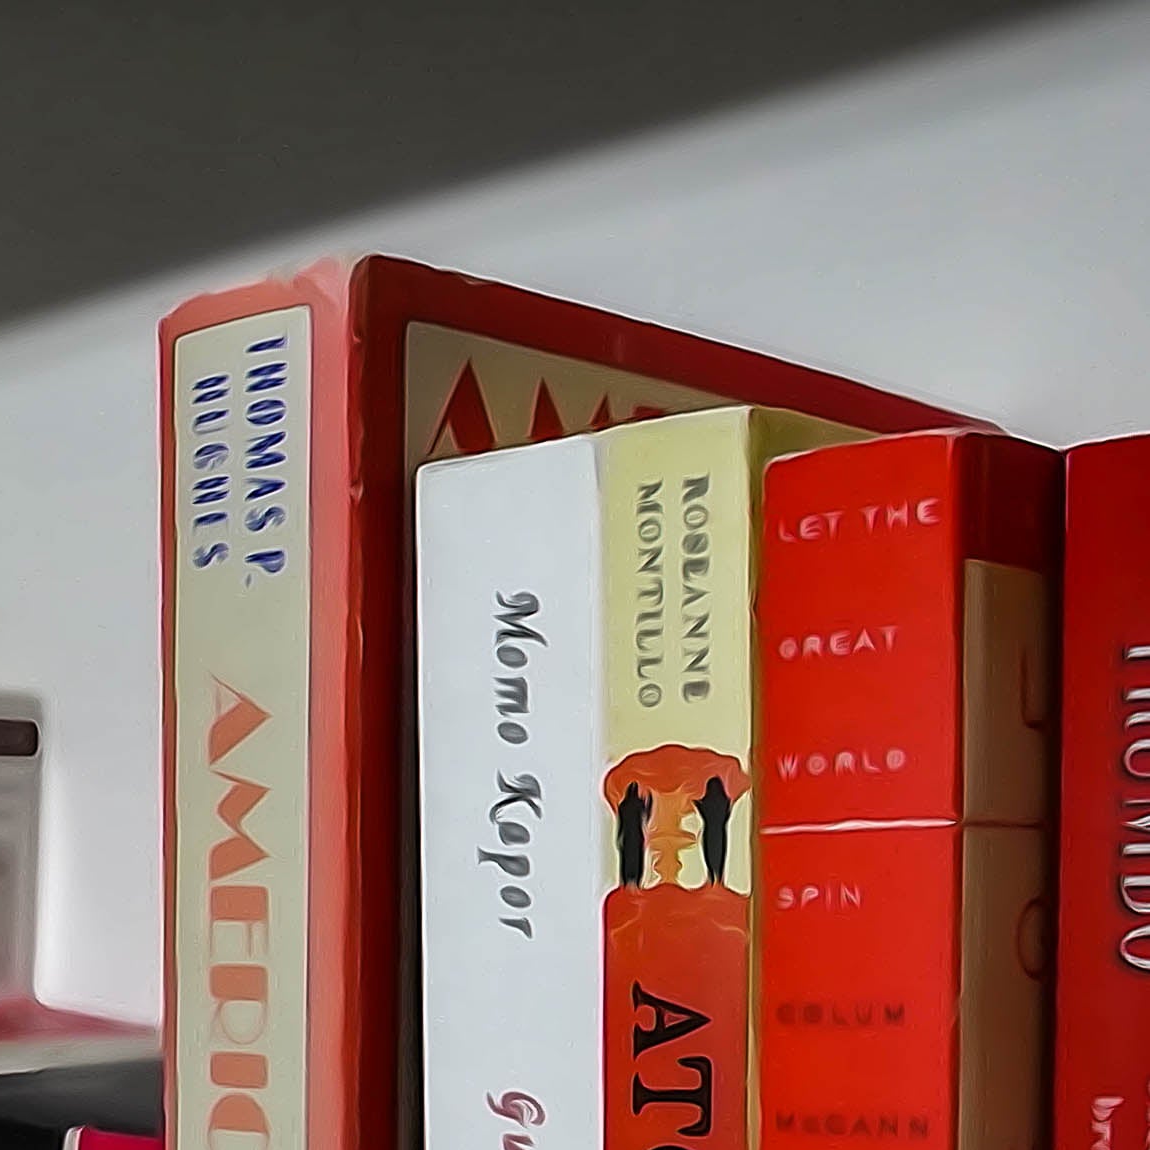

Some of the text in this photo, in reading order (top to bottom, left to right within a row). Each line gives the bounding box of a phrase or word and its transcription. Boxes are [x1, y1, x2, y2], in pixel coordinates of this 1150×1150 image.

[777, 498, 941, 543] LET THE
[635, 481, 665, 709] MONTILLO
[680, 473, 711, 704] ROSEANNE
[778, 625, 899, 658] GREAT
[492, 590, 547, 745] Momo
[776, 748, 907, 782] WORLD
[777, 883, 863, 911] SPIN
[775, 1002, 906, 1026] COLUM
